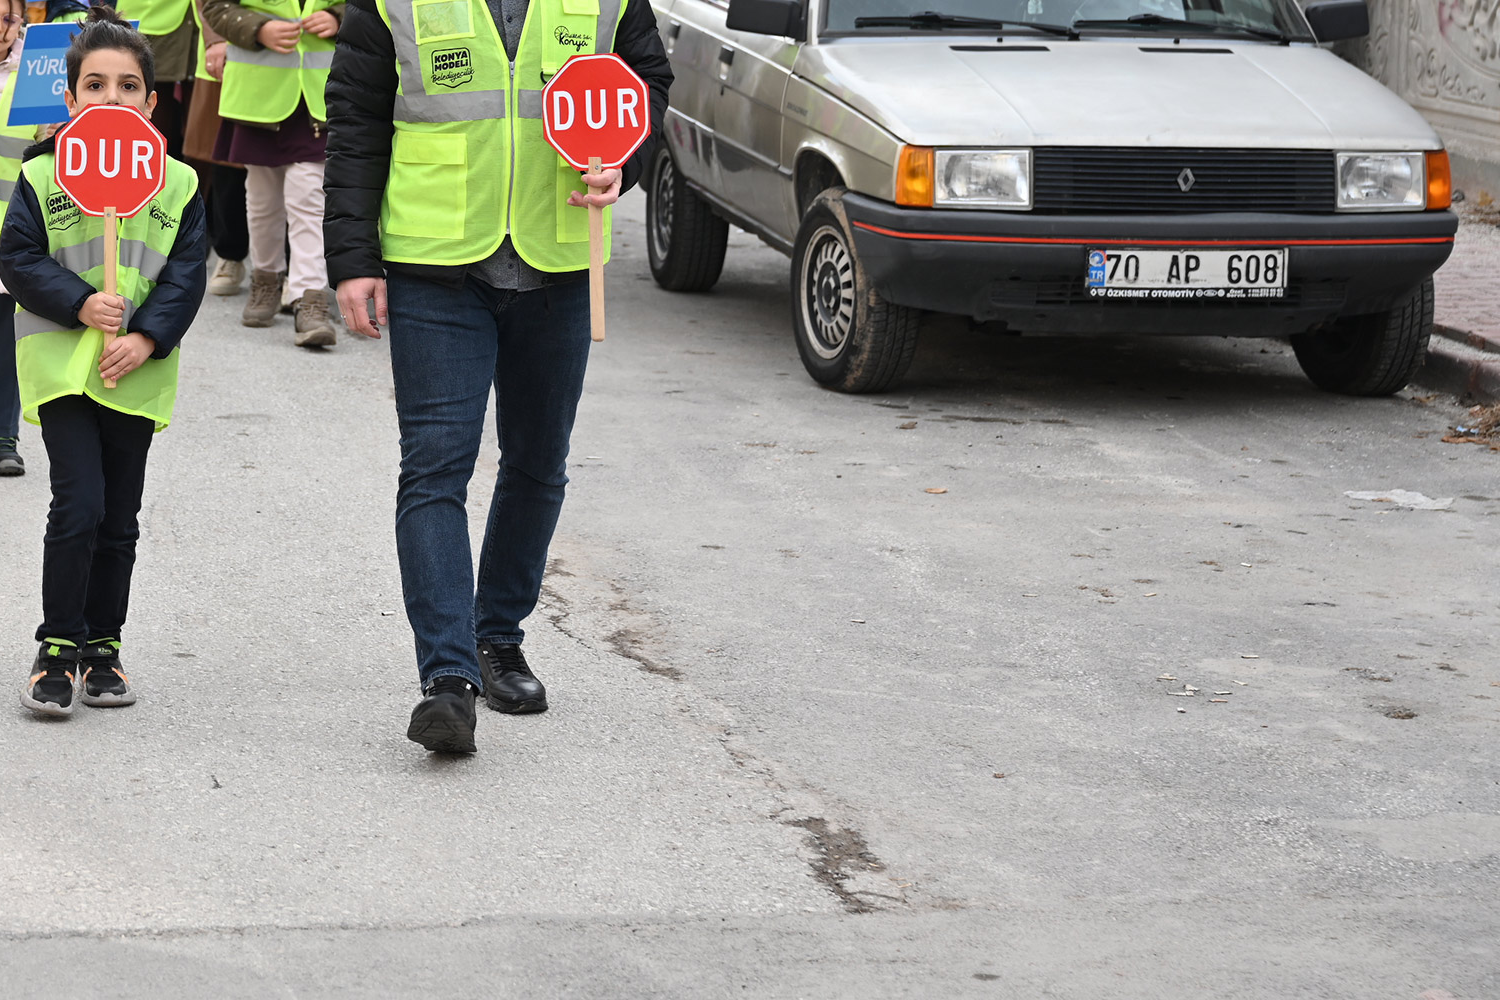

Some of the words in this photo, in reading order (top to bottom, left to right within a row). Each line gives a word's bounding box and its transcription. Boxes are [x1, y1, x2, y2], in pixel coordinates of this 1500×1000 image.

[558, 32, 588, 52] Konya
[434, 50, 468, 64] KONYA
[553, 88, 639, 131] DUR
[65, 137, 155, 180] DUR
[149, 205, 174, 230] Konya
[1090, 270, 1104, 280] TR
[1106, 254, 1140, 284] 70
[1167, 254, 1201, 284] AP
[1227, 254, 1278, 284] 608
[1107, 288, 1150, 298] ÖZKISMET
[1151, 287, 1195, 298] OTOMOTİV
